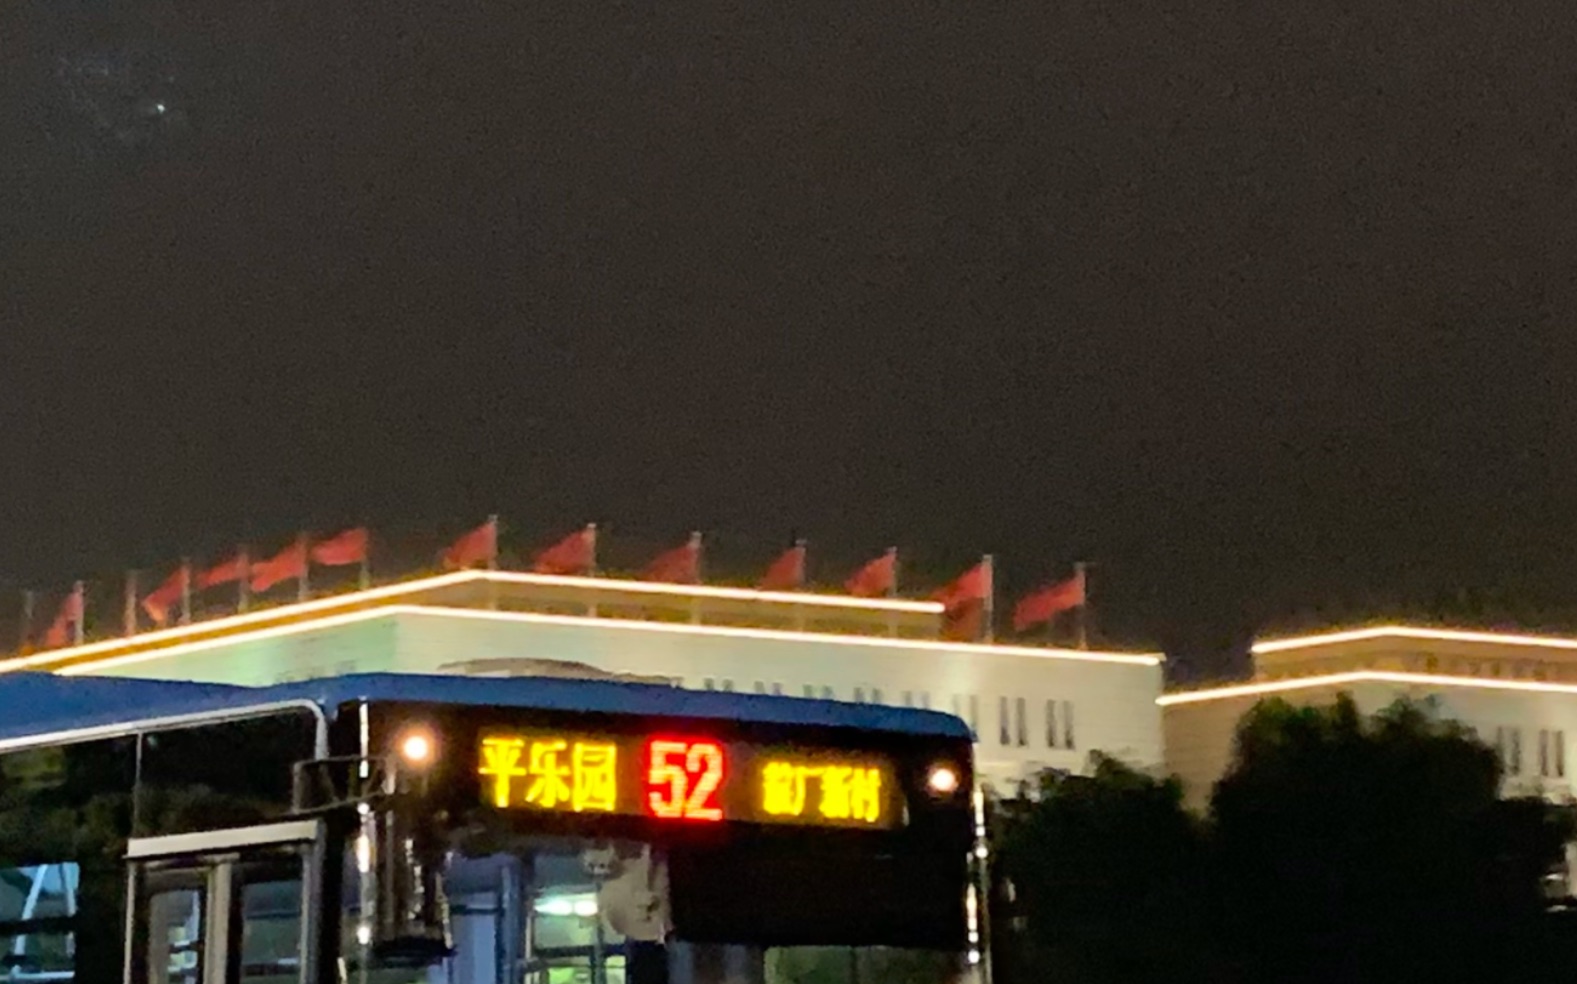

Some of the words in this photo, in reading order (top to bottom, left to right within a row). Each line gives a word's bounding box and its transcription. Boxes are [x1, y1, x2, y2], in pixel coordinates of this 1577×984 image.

[478, 738, 617, 812] 平乐园
[648, 740, 723, 820] 52
